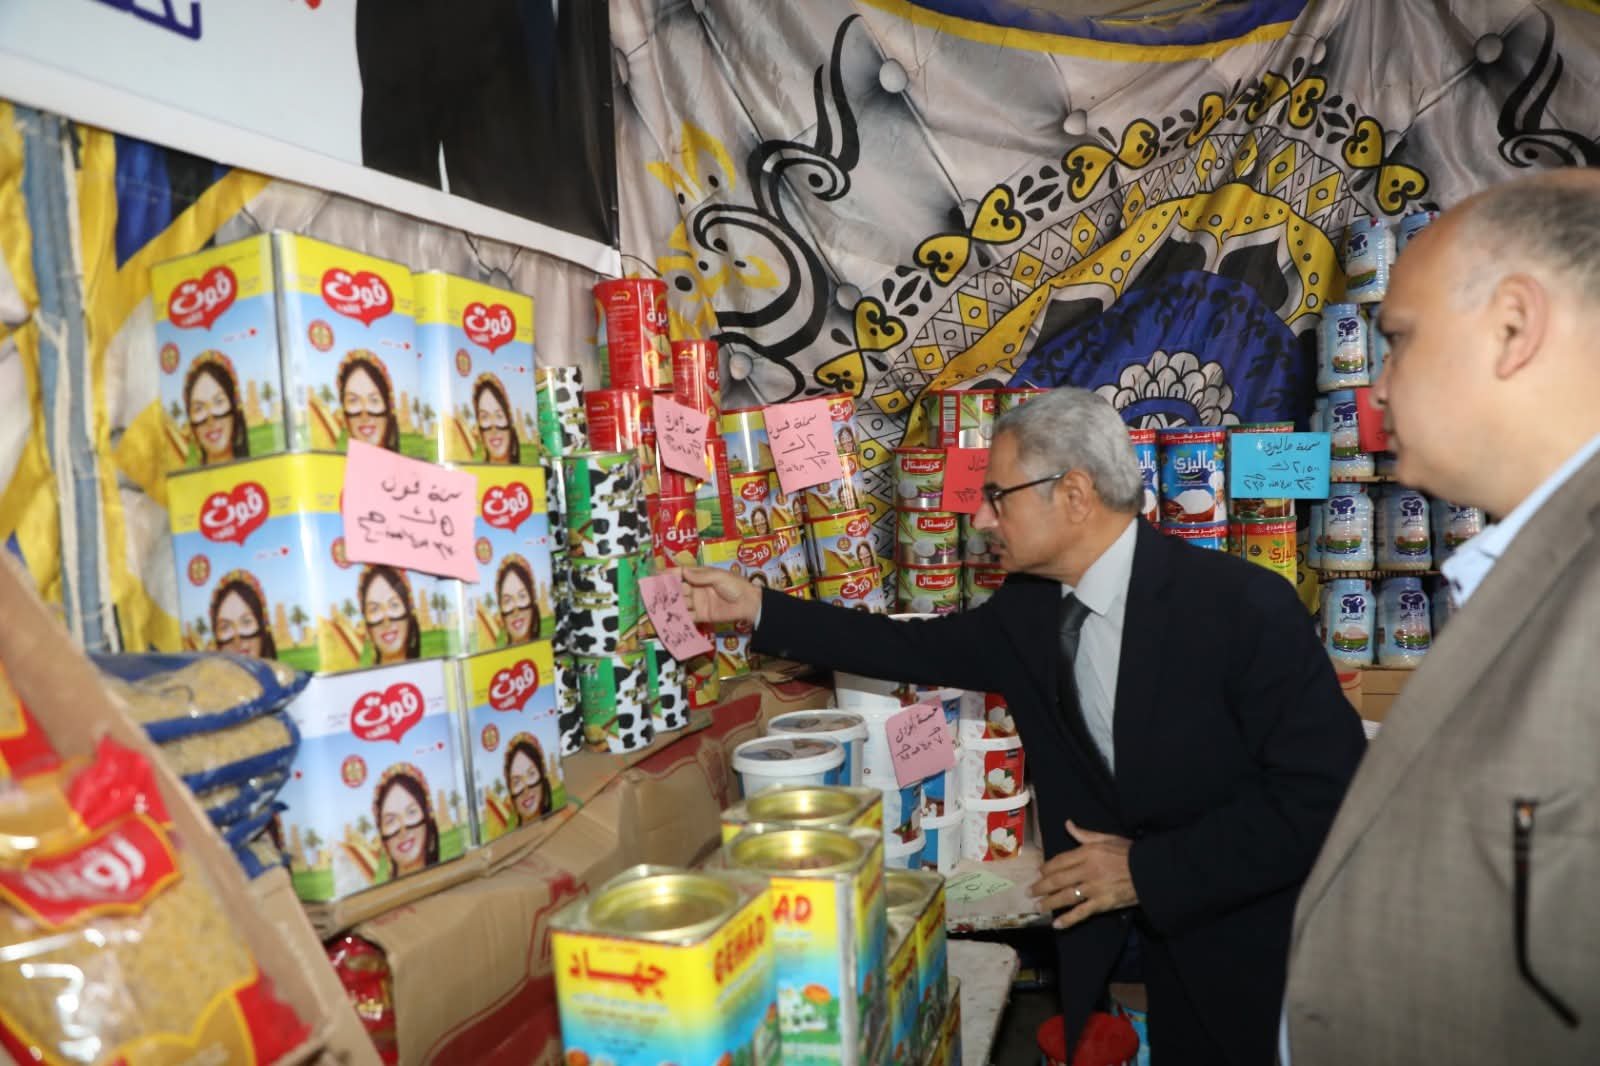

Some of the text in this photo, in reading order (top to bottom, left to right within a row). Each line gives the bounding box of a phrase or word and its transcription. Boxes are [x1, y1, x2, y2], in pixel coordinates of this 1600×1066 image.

[170, 270, 233, 317] قوت
[324, 272, 388, 308] قوت
[465, 306, 513, 337] قوت
[903, 460, 941, 472] كريستال
[1173, 450, 1217, 474] ماليزي
[484, 488, 530, 517] قوت
[743, 482, 769, 496] قوت
[203, 486, 265, 527] قوت
[919, 518, 955, 530] كريستال
[737, 543, 770, 563] قوت
[1269, 538, 1297, 565] ليزي
[841, 579, 871, 595] قوت
[918, 574, 954, 587] كريستال
[491, 663, 536, 700] قوت
[353, 686, 419, 727] قوت
[713, 913, 767, 985] GEHAD
[569, 946, 669, 1002] جهاد
